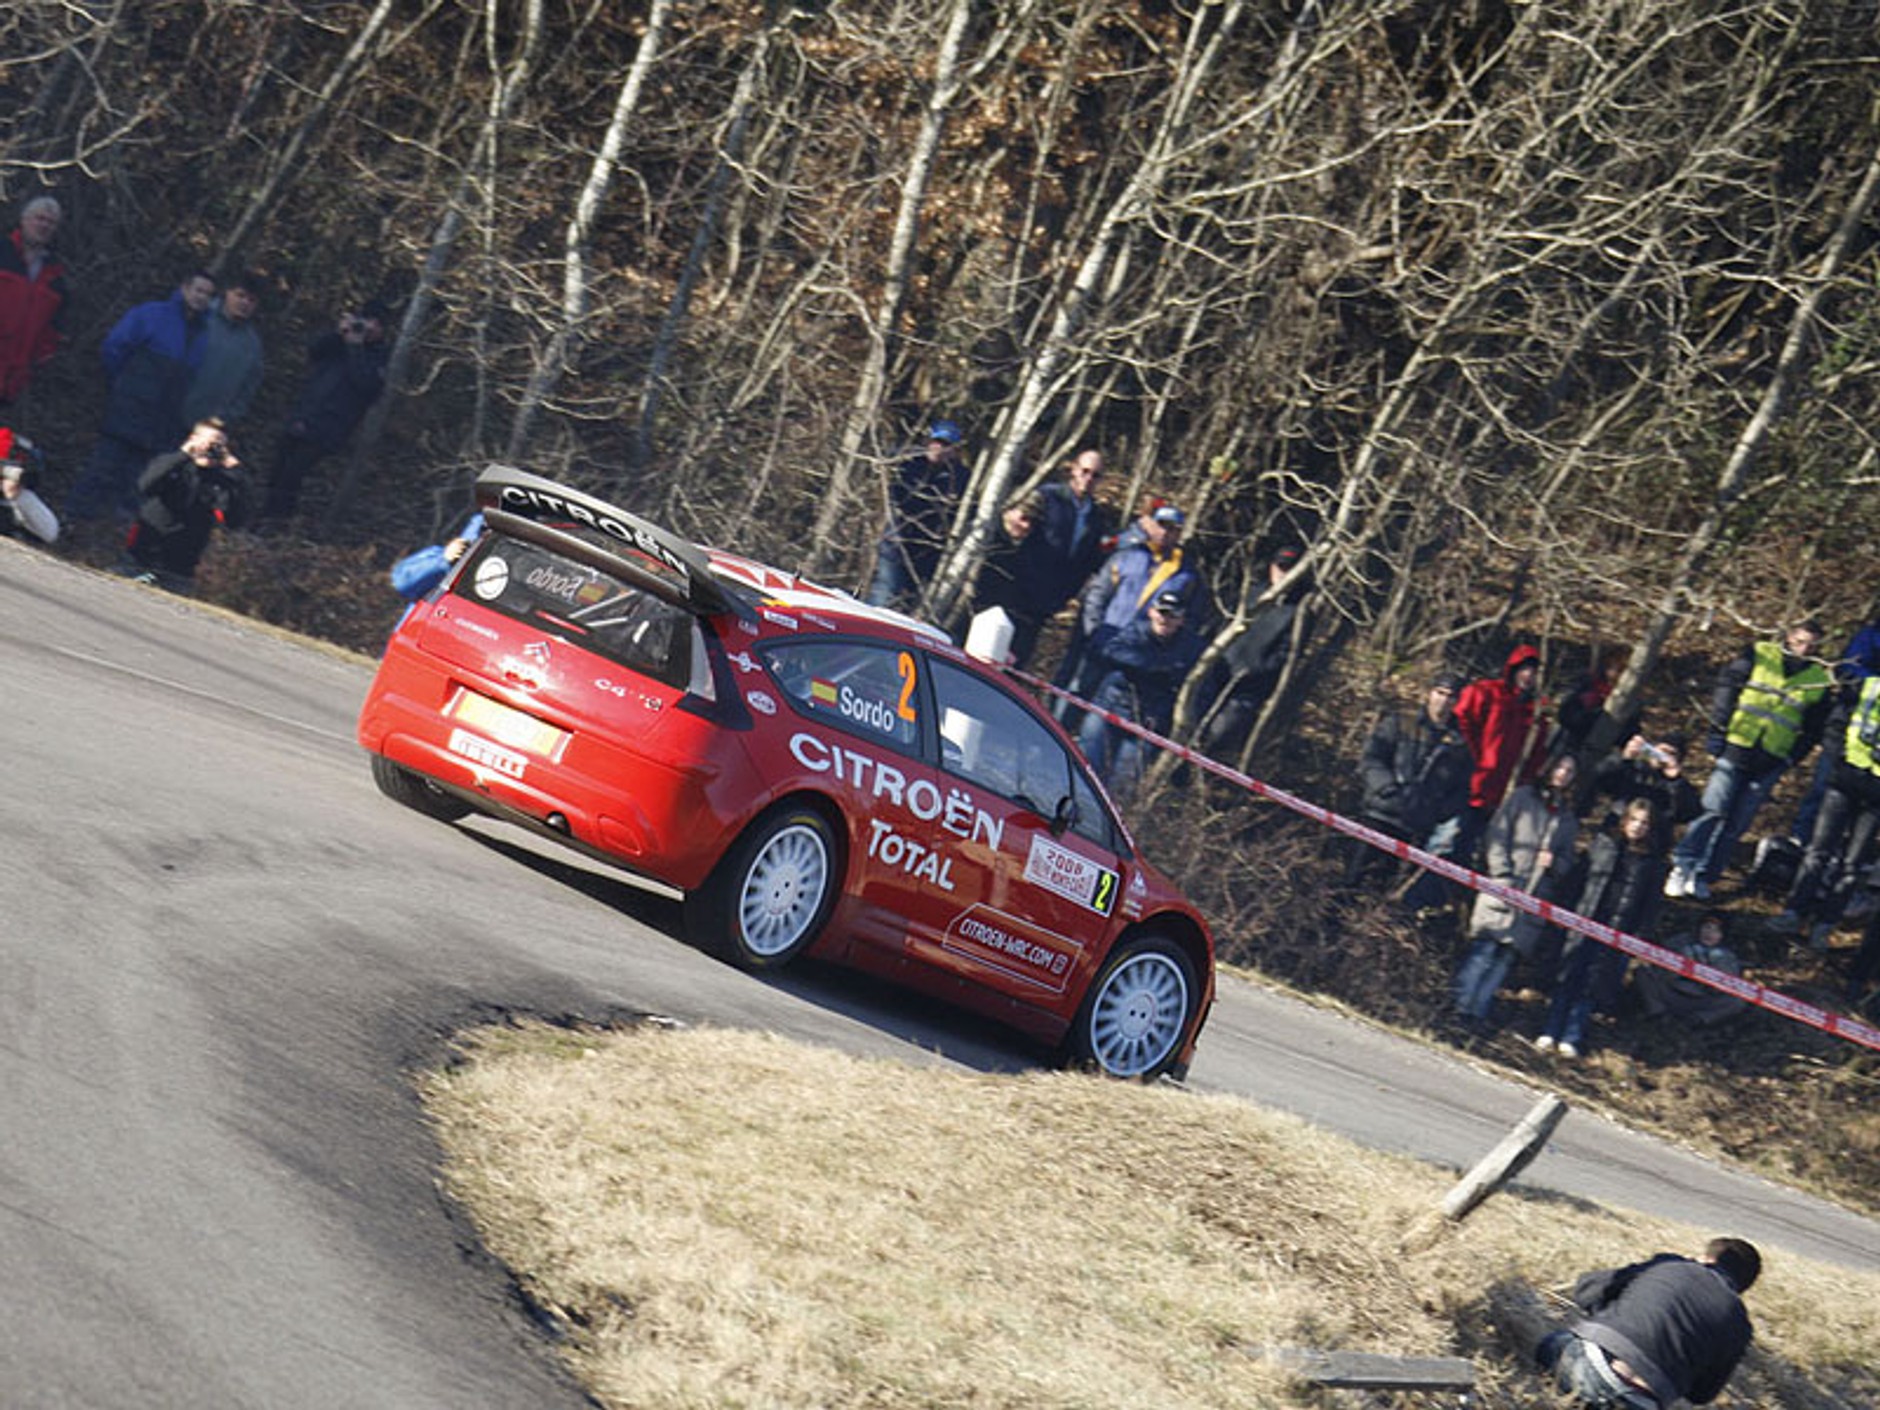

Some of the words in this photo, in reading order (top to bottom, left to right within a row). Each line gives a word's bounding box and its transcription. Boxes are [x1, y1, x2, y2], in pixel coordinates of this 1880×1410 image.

[839, 685, 895, 732] Sordo
[897, 651, 917, 723] 2
[789, 732, 1005, 852] CITROËN
[867, 817, 956, 891] TOTAL
[1045, 848, 1085, 876] 2008
[1094, 872, 1113, 911] 2
